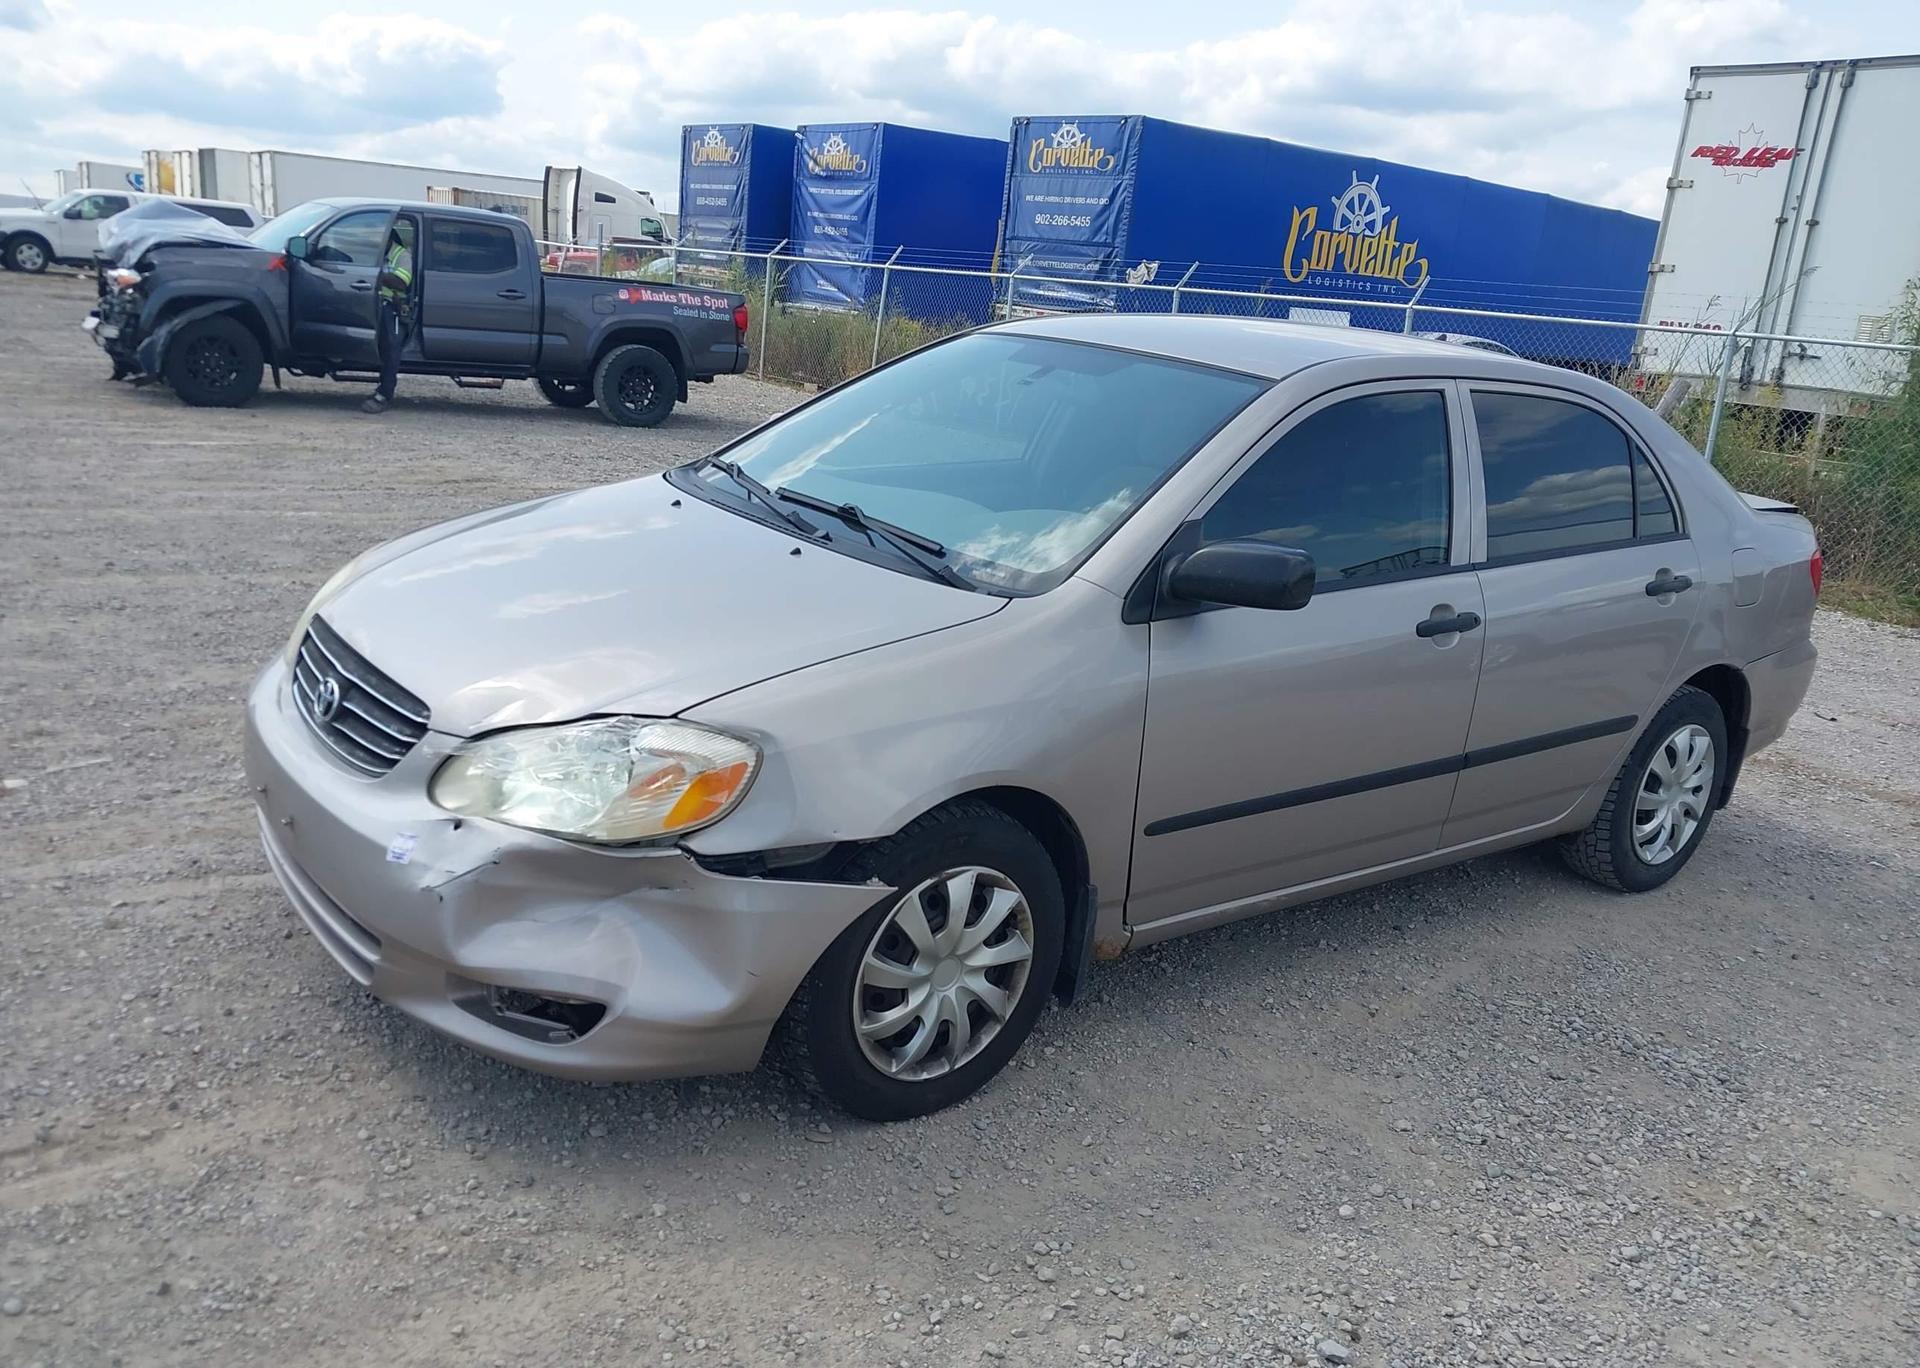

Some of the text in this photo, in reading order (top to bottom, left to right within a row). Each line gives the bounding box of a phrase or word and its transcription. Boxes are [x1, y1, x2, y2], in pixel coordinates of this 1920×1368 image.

[1028, 136, 1115, 173] Corvette
[1691, 145, 1741, 158] RED
[1086, 197, 1098, 205] AND
[1034, 213, 1092, 227] 902-266-5455
[1283, 205, 1429, 288] Corvette
[1308, 275, 1401, 295] LOGISTICS INC.
[641, 288, 677, 303] Marks
[678, 293, 701, 306] The
[703, 295, 729, 310] Spot
[673, 305, 698, 318] Sealed
[709, 310, 730, 321] Stone
